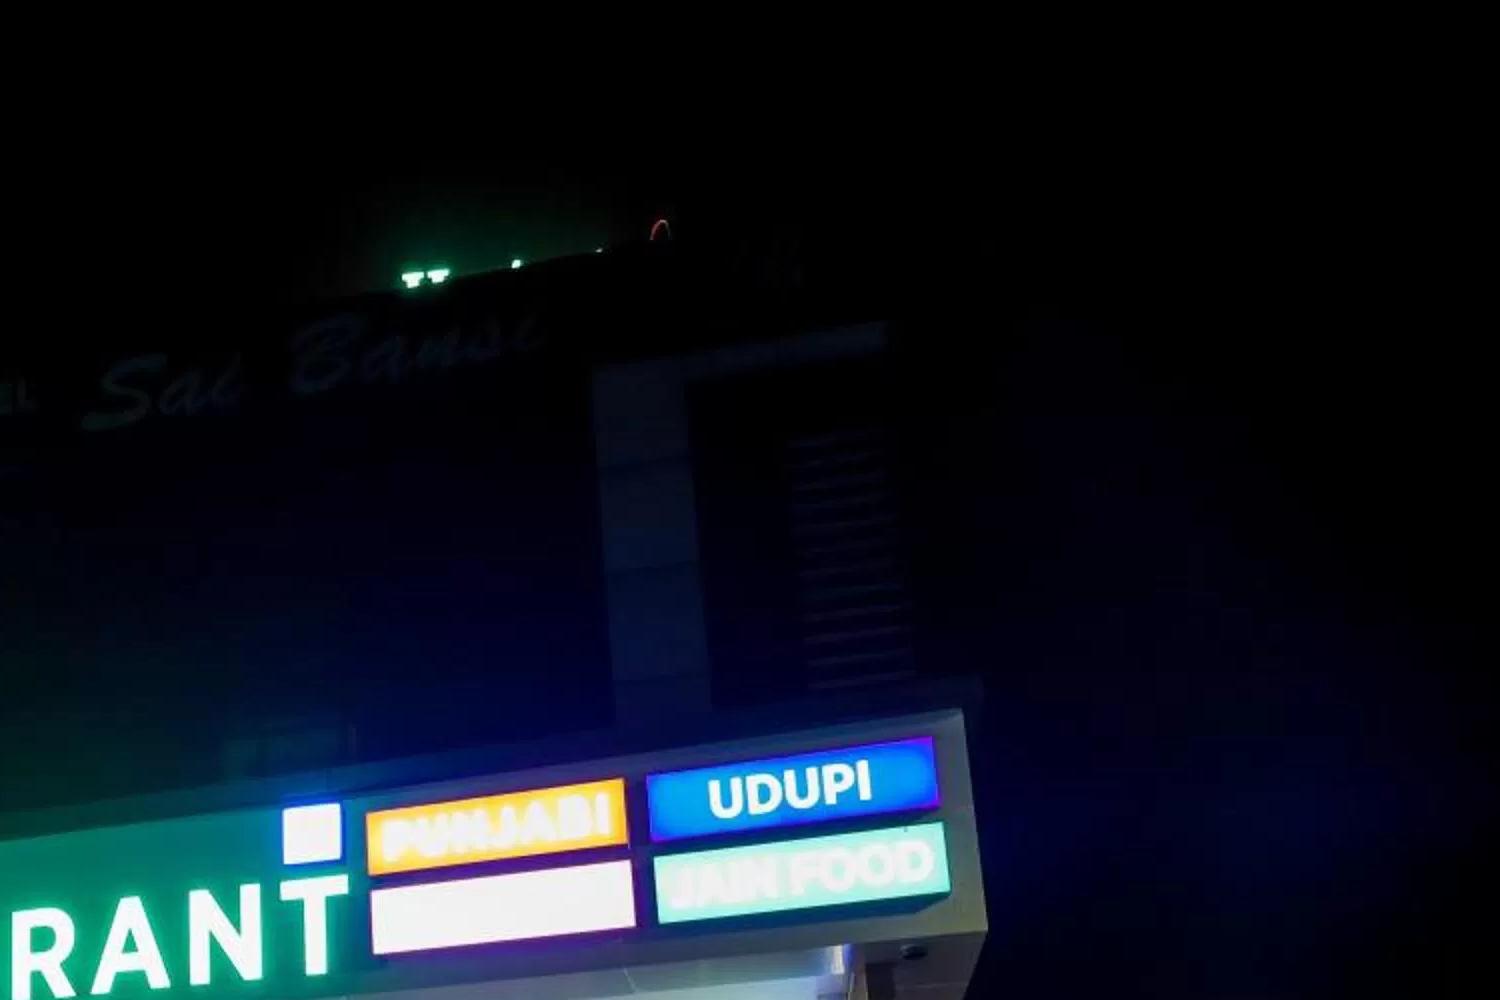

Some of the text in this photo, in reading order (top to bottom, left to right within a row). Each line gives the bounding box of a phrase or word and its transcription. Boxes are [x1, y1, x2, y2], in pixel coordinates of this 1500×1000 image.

[706, 759, 874, 819] UDUPI
[381, 792, 612, 862] PUNJABI
[669, 840, 936, 909] JAIN FOOD
